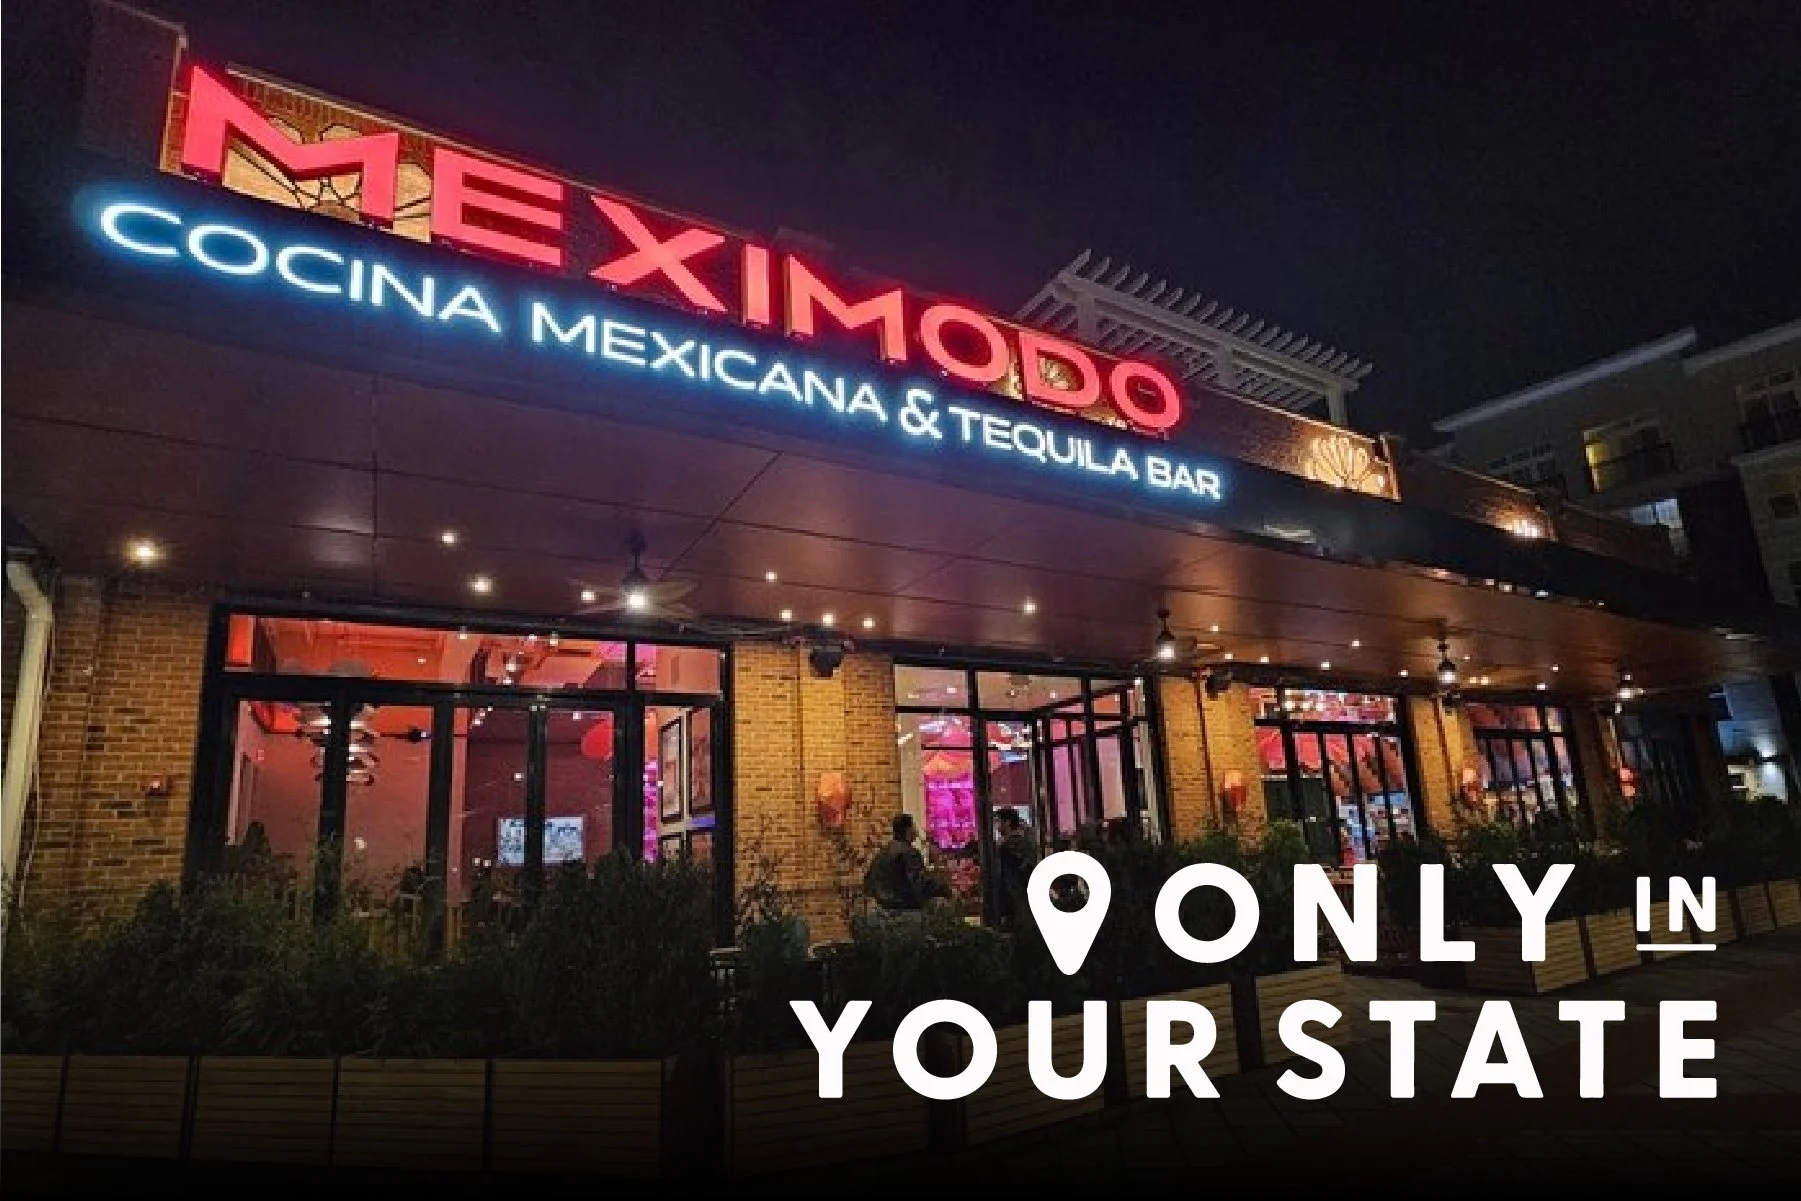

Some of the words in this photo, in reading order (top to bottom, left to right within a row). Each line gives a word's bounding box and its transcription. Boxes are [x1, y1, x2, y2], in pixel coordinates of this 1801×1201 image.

[100, 202, 501, 332] COCINA
[532, 302, 888, 422] MEXICANA
[899, 389, 942, 439] &
[949, 407, 1138, 480] TEQUILA
[1146, 455, 1221, 500] BAR
[182, 65, 1181, 429] MEXIMODO
